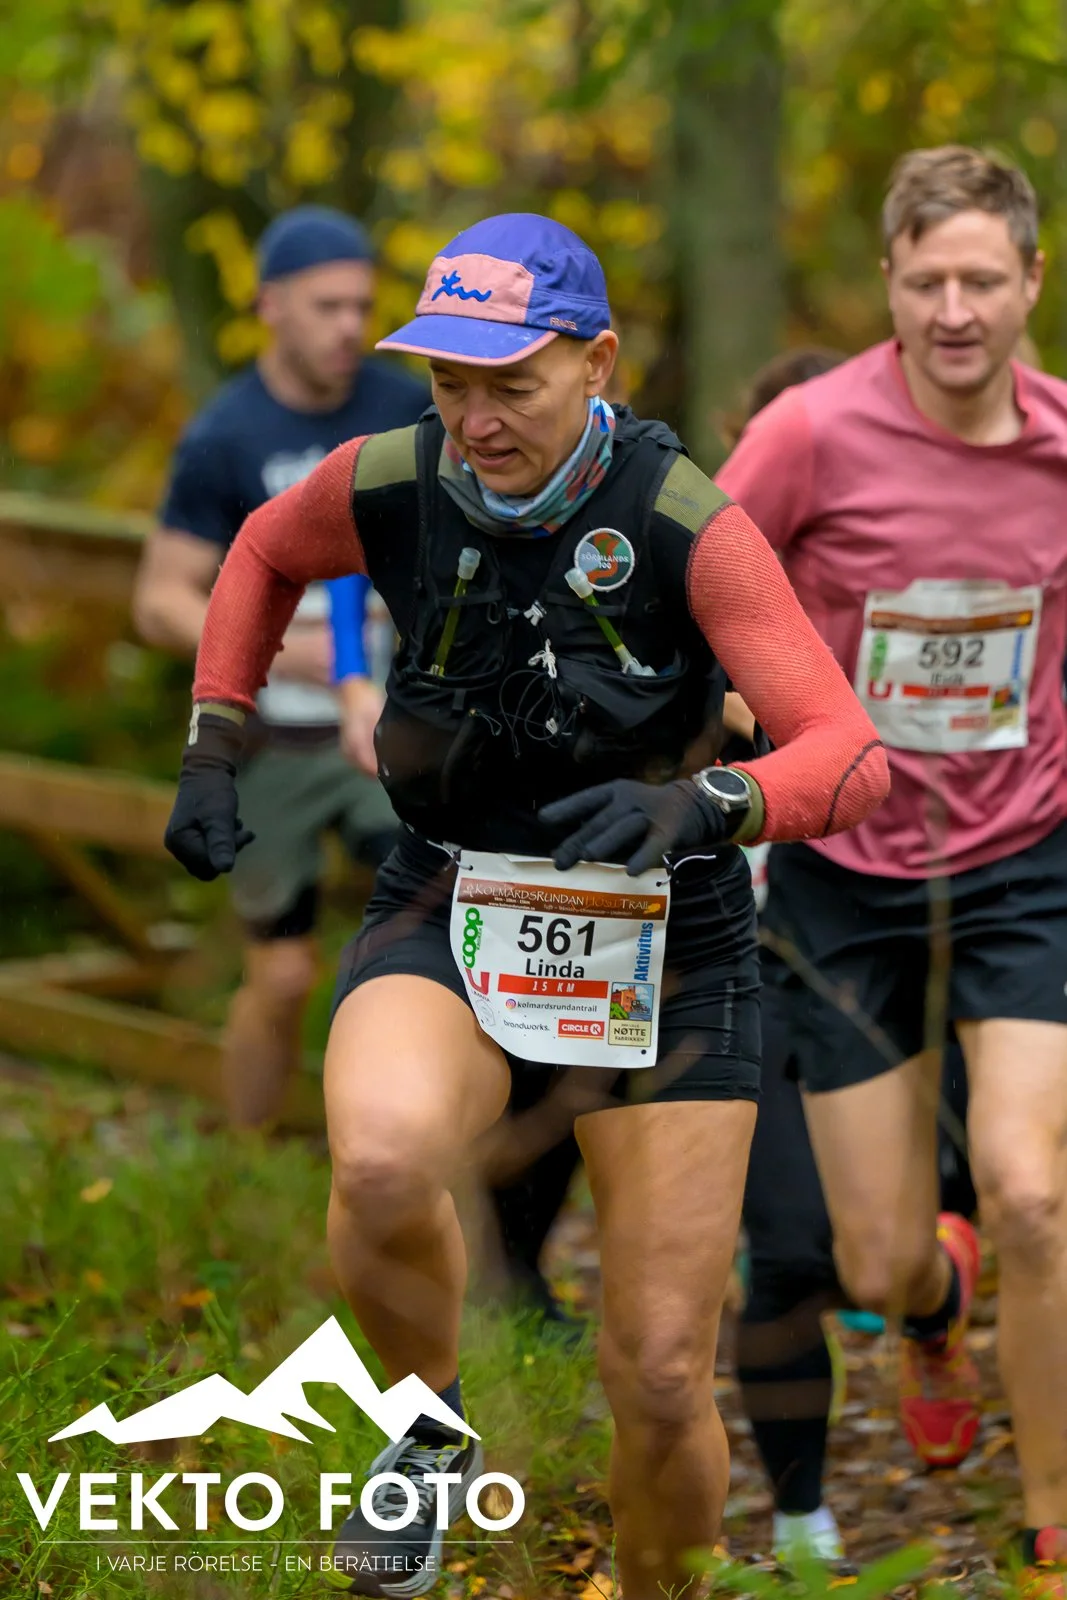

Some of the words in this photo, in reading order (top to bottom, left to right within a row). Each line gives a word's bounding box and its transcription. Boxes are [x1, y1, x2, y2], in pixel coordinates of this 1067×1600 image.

[598, 561, 612, 570] 100
[917, 638, 985, 670] 592
[462, 907, 483, 969] coop
[517, 914, 596, 957] 561
[633, 922, 654, 981] Aktivitus
[525, 957, 585, 979] Linda
[532, 980, 548, 992] 15
[557, 982, 575, 993] KM
[517, 1000, 597, 1013] kolmardsrundantrail
[561, 1023, 589, 1033] CIRCLE
[591, 1024, 601, 1035] K
